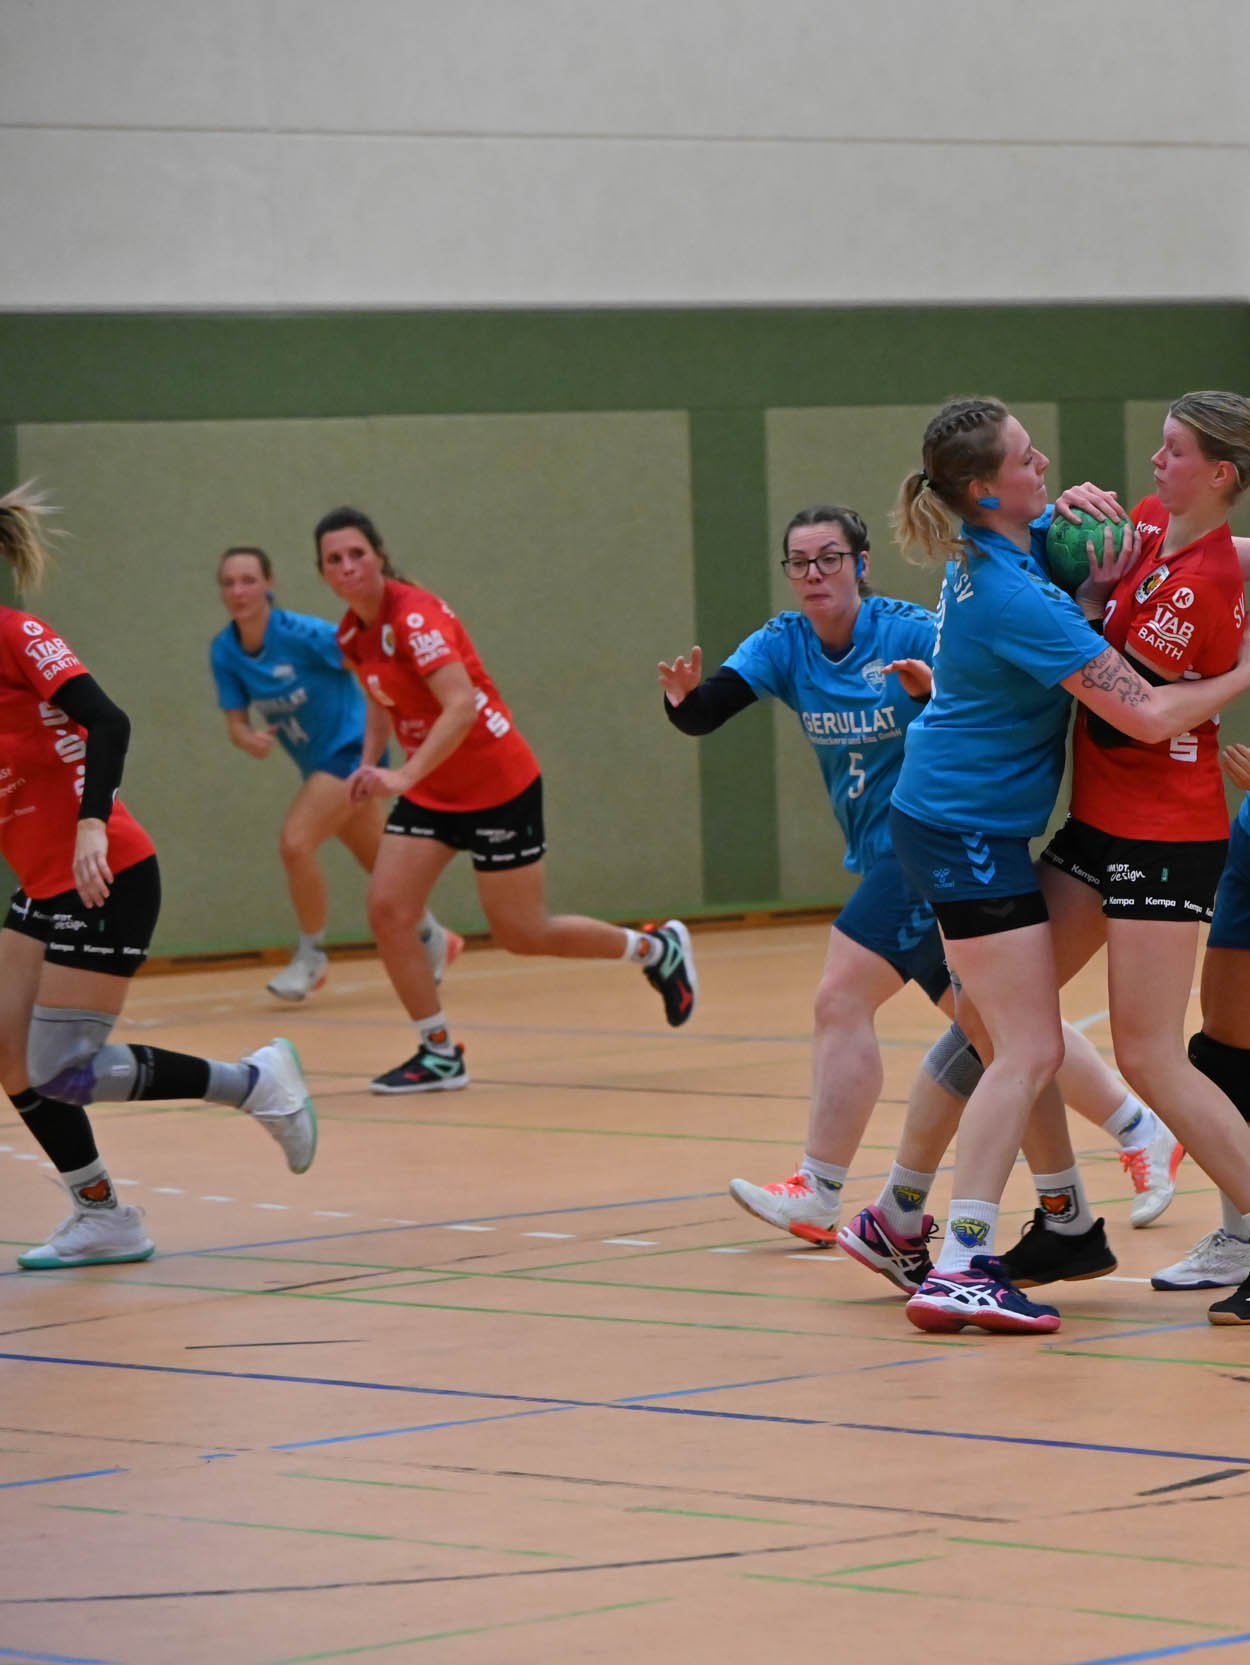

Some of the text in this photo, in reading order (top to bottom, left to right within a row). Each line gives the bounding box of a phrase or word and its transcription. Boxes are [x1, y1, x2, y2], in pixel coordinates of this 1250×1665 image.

[1138, 627, 1184, 660] BARTH
[43, 656, 81, 681] BARTH
[802, 705, 897, 735] GERULLAT
[848, 752, 866, 799] 5
[1071, 863, 1101, 886] Kempa
[1109, 896, 1135, 906] Kempa
[1145, 896, 1177, 908] Kempa
